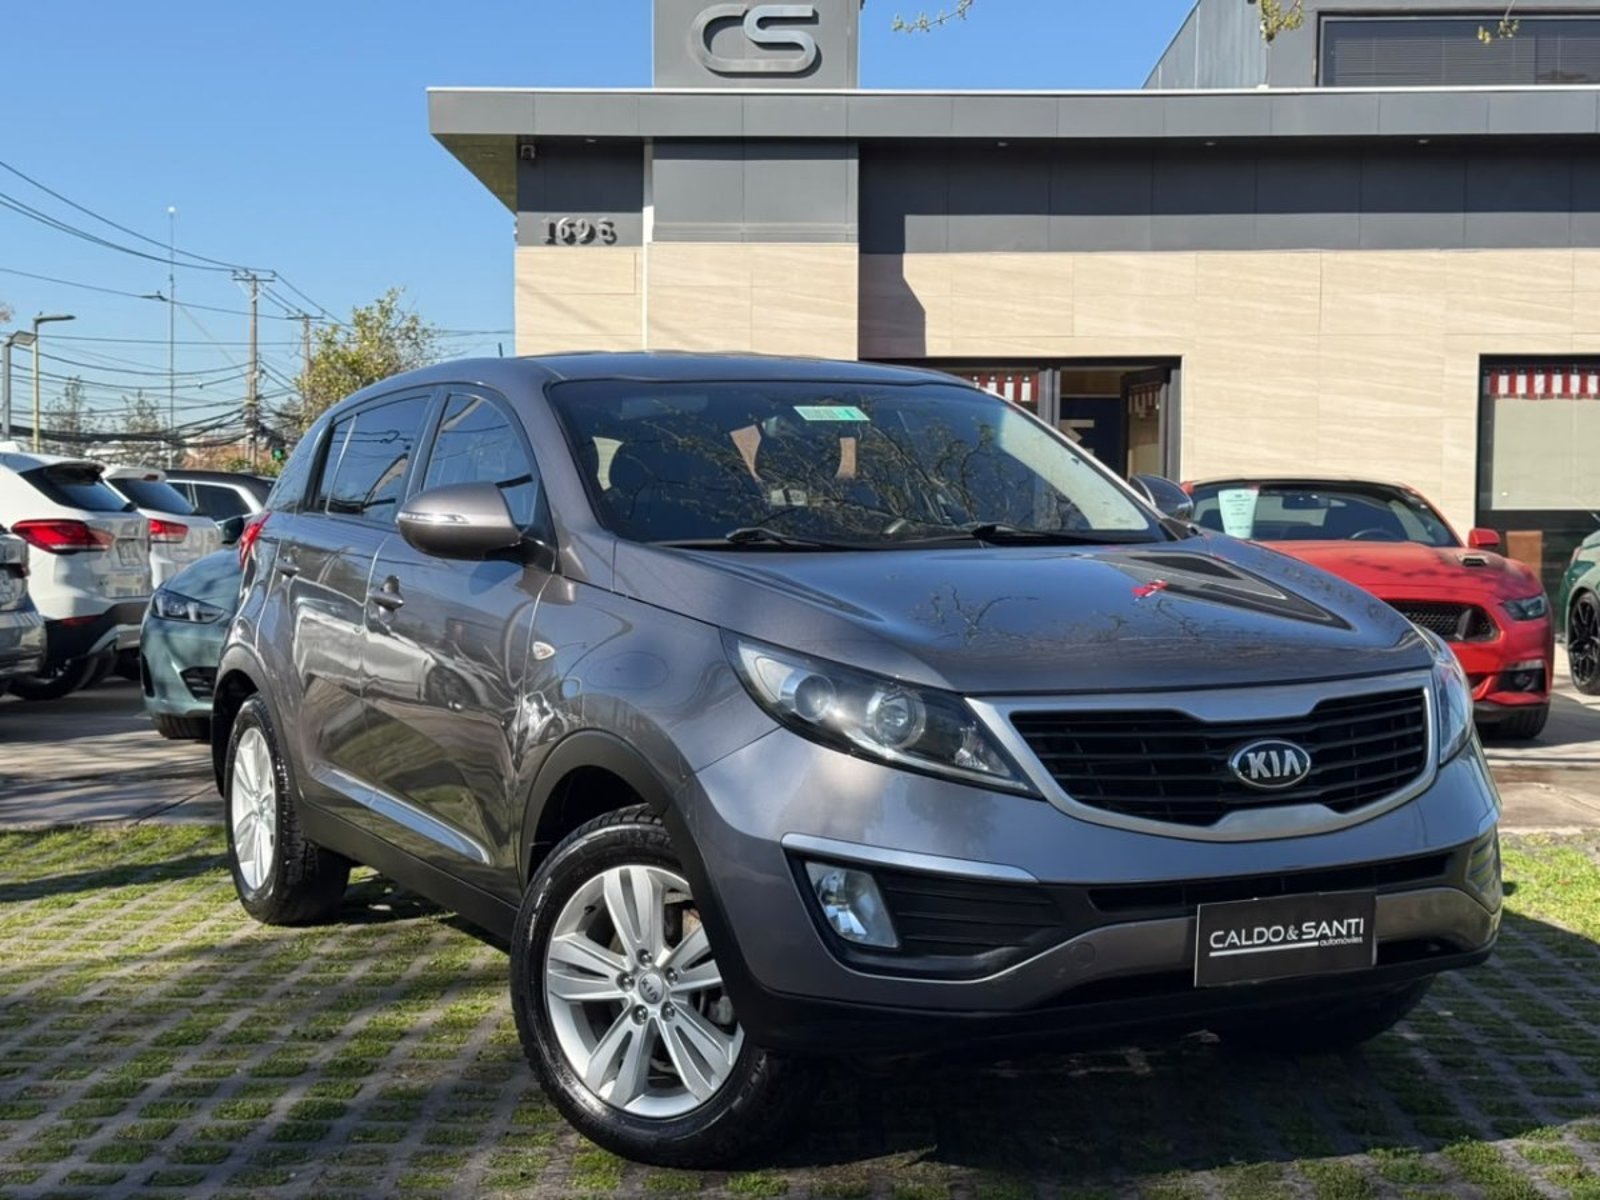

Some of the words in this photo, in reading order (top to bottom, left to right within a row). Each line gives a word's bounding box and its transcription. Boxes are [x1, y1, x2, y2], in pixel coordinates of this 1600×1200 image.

[692, 4, 816, 74] CS
[1246, 749, 1301, 779] KIA
[641, 978, 658, 1000] KIA
